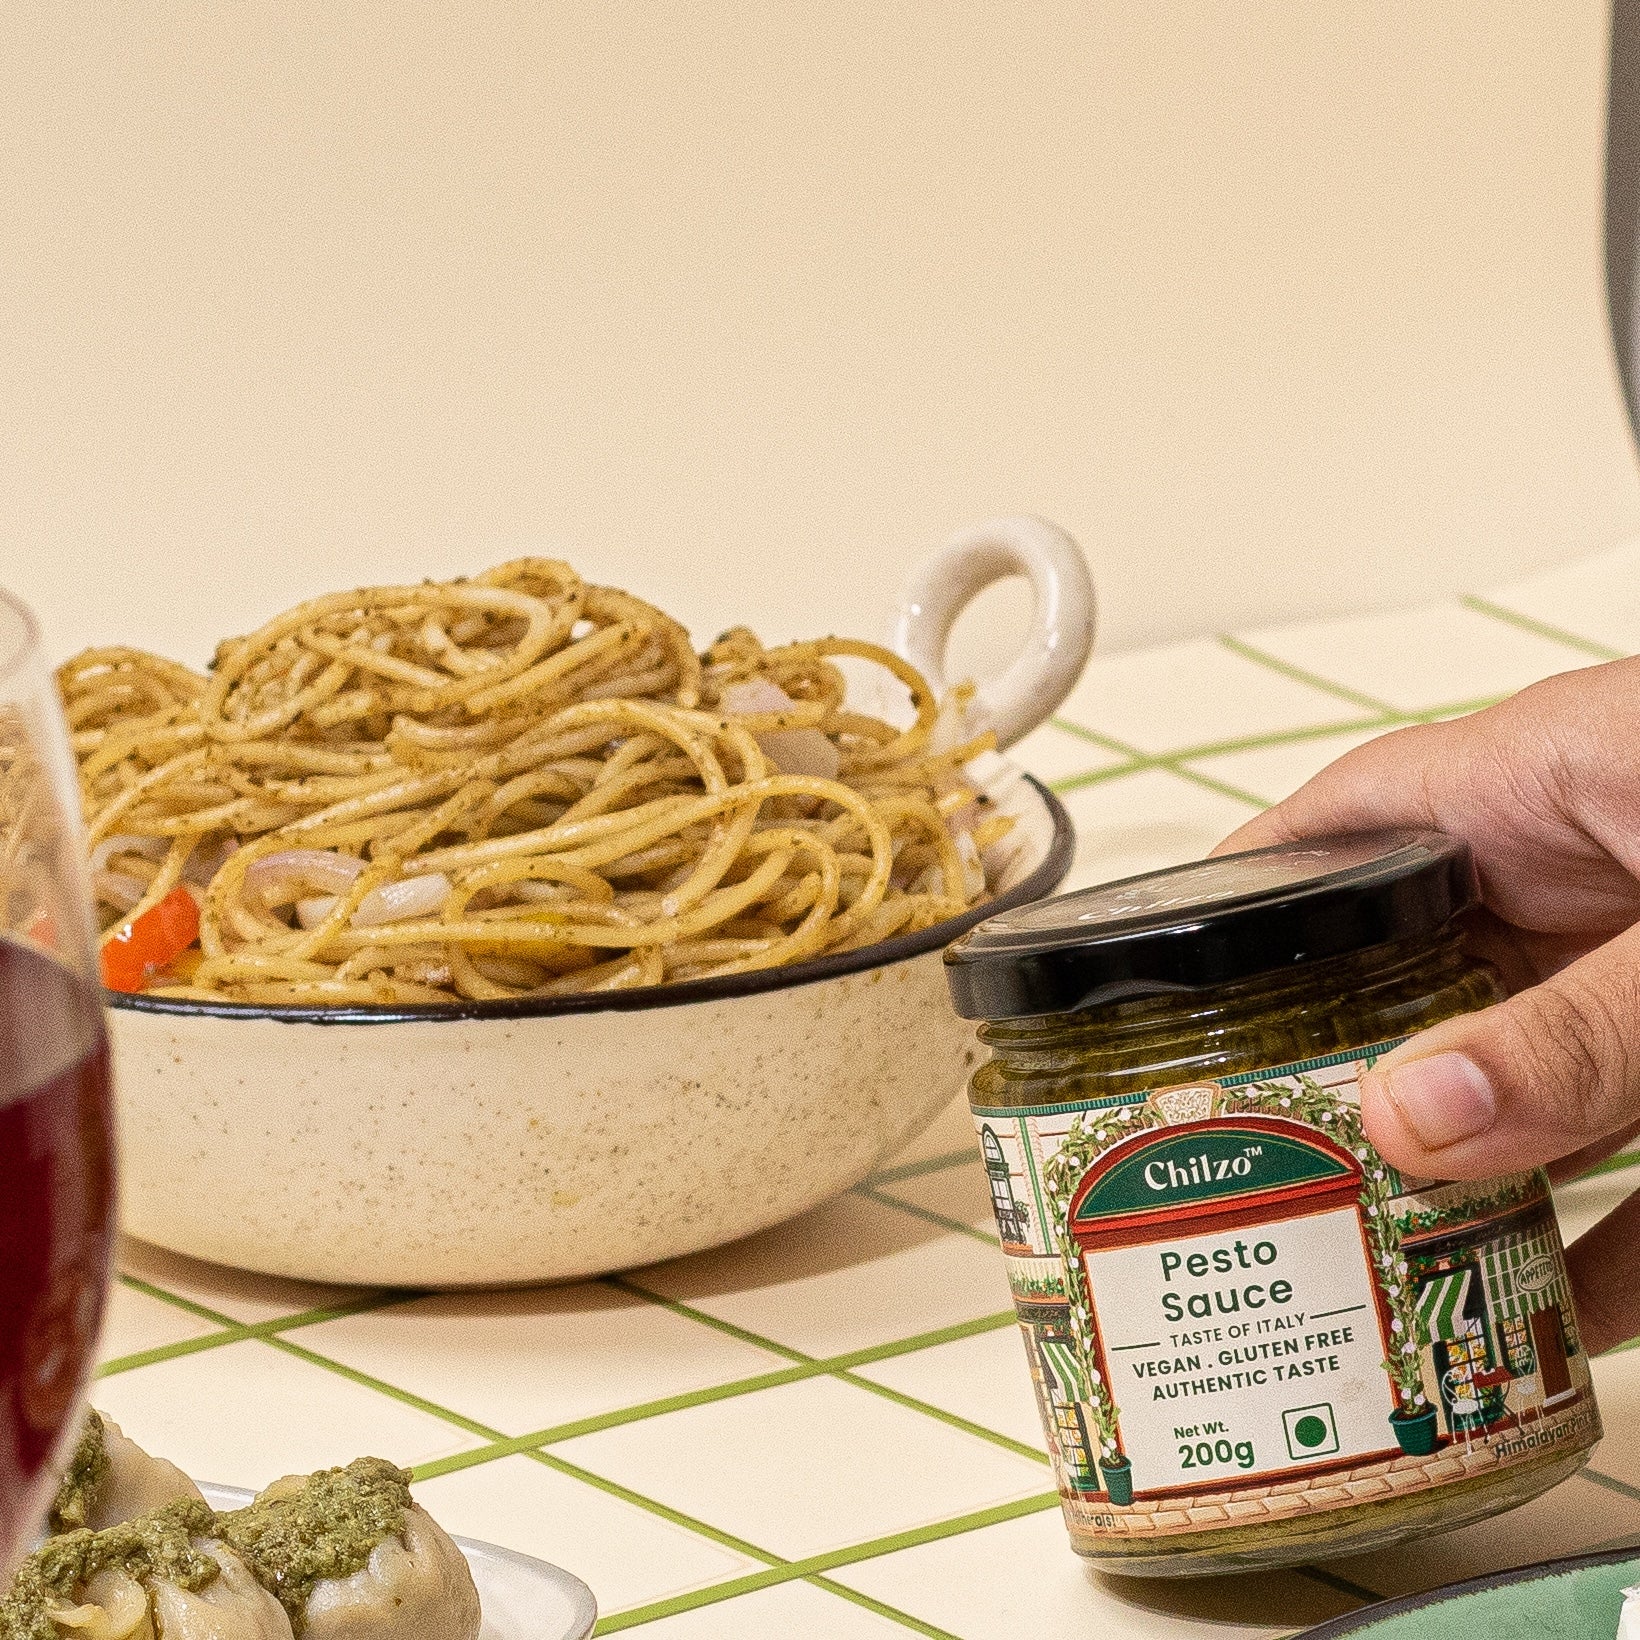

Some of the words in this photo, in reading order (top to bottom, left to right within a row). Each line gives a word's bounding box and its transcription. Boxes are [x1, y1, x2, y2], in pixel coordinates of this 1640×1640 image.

[1160, 1240, 1278, 1282] Pesto
[1161, 1279, 1293, 1322] Sauce
[1170, 1327, 1223, 1348] TASTE
[1227, 1322, 1251, 1339] OF
[1256, 1312, 1306, 1334] ITALY
[1132, 1355, 1201, 1379] VEGAN
[1217, 1338, 1300, 1367] GLUTEN
[1304, 1326, 1355, 1351] FREE
[1152, 1368, 1268, 1401] AUTHENTIC
[1272, 1354, 1341, 1382] TASTE
[1173, 1426, 1201, 1440] Net
[1202, 1421, 1230, 1436] Wt.
[1495, 1422, 1571, 1458] Himalayan
[1178, 1438, 1255, 1469] 200g
